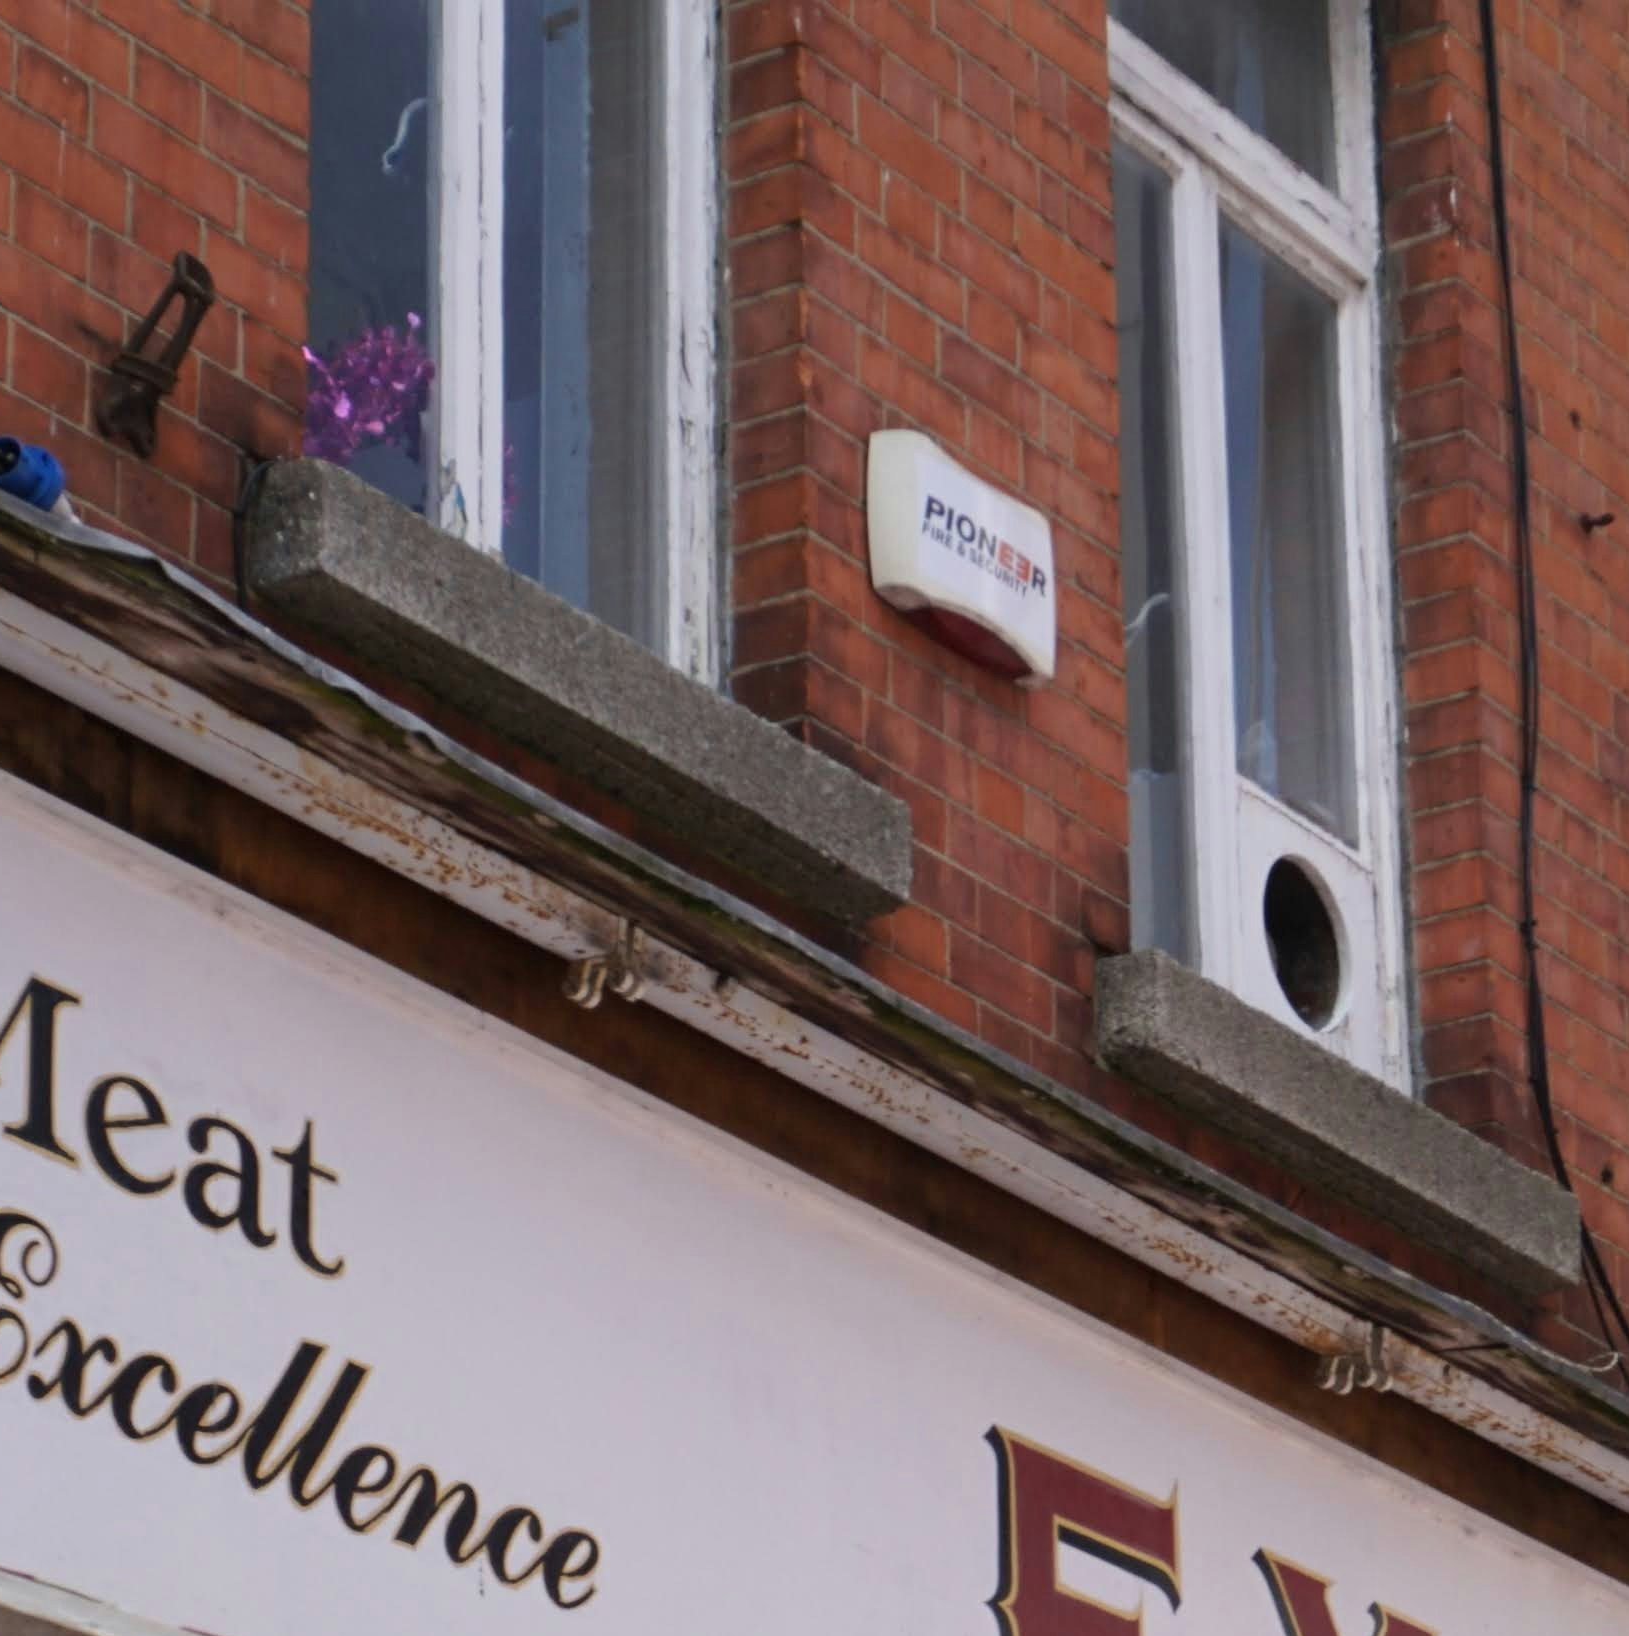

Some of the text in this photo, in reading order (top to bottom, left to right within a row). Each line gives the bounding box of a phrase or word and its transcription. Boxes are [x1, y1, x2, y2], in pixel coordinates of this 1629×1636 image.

[921, 520, 954, 551] FIRE
[969, 546, 1030, 599] SECURITY
[924, 494, 1047, 598] PIONEER
